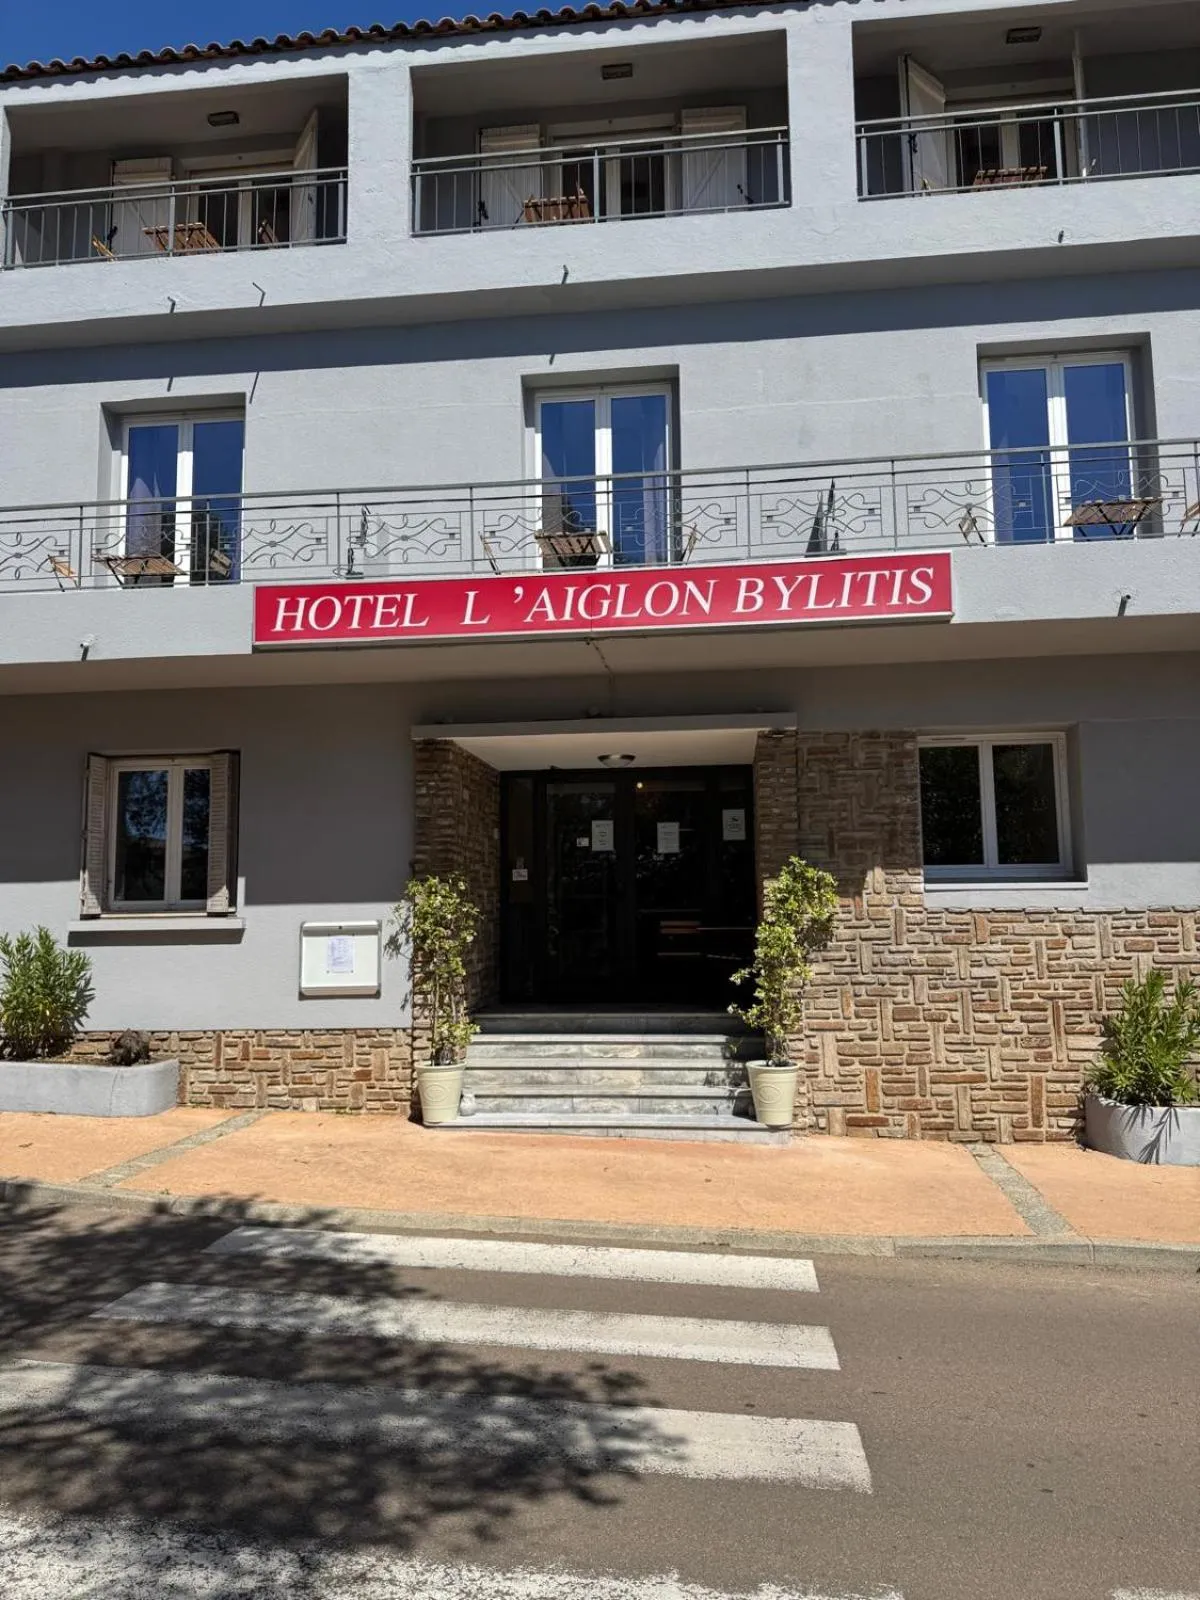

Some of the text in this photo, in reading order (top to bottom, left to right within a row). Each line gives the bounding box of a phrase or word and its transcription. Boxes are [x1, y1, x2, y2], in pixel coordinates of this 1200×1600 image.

[271, 593, 429, 632] HOTEL
[460, 591, 490, 625] L
[731, 567, 934, 613] BYLITIS
